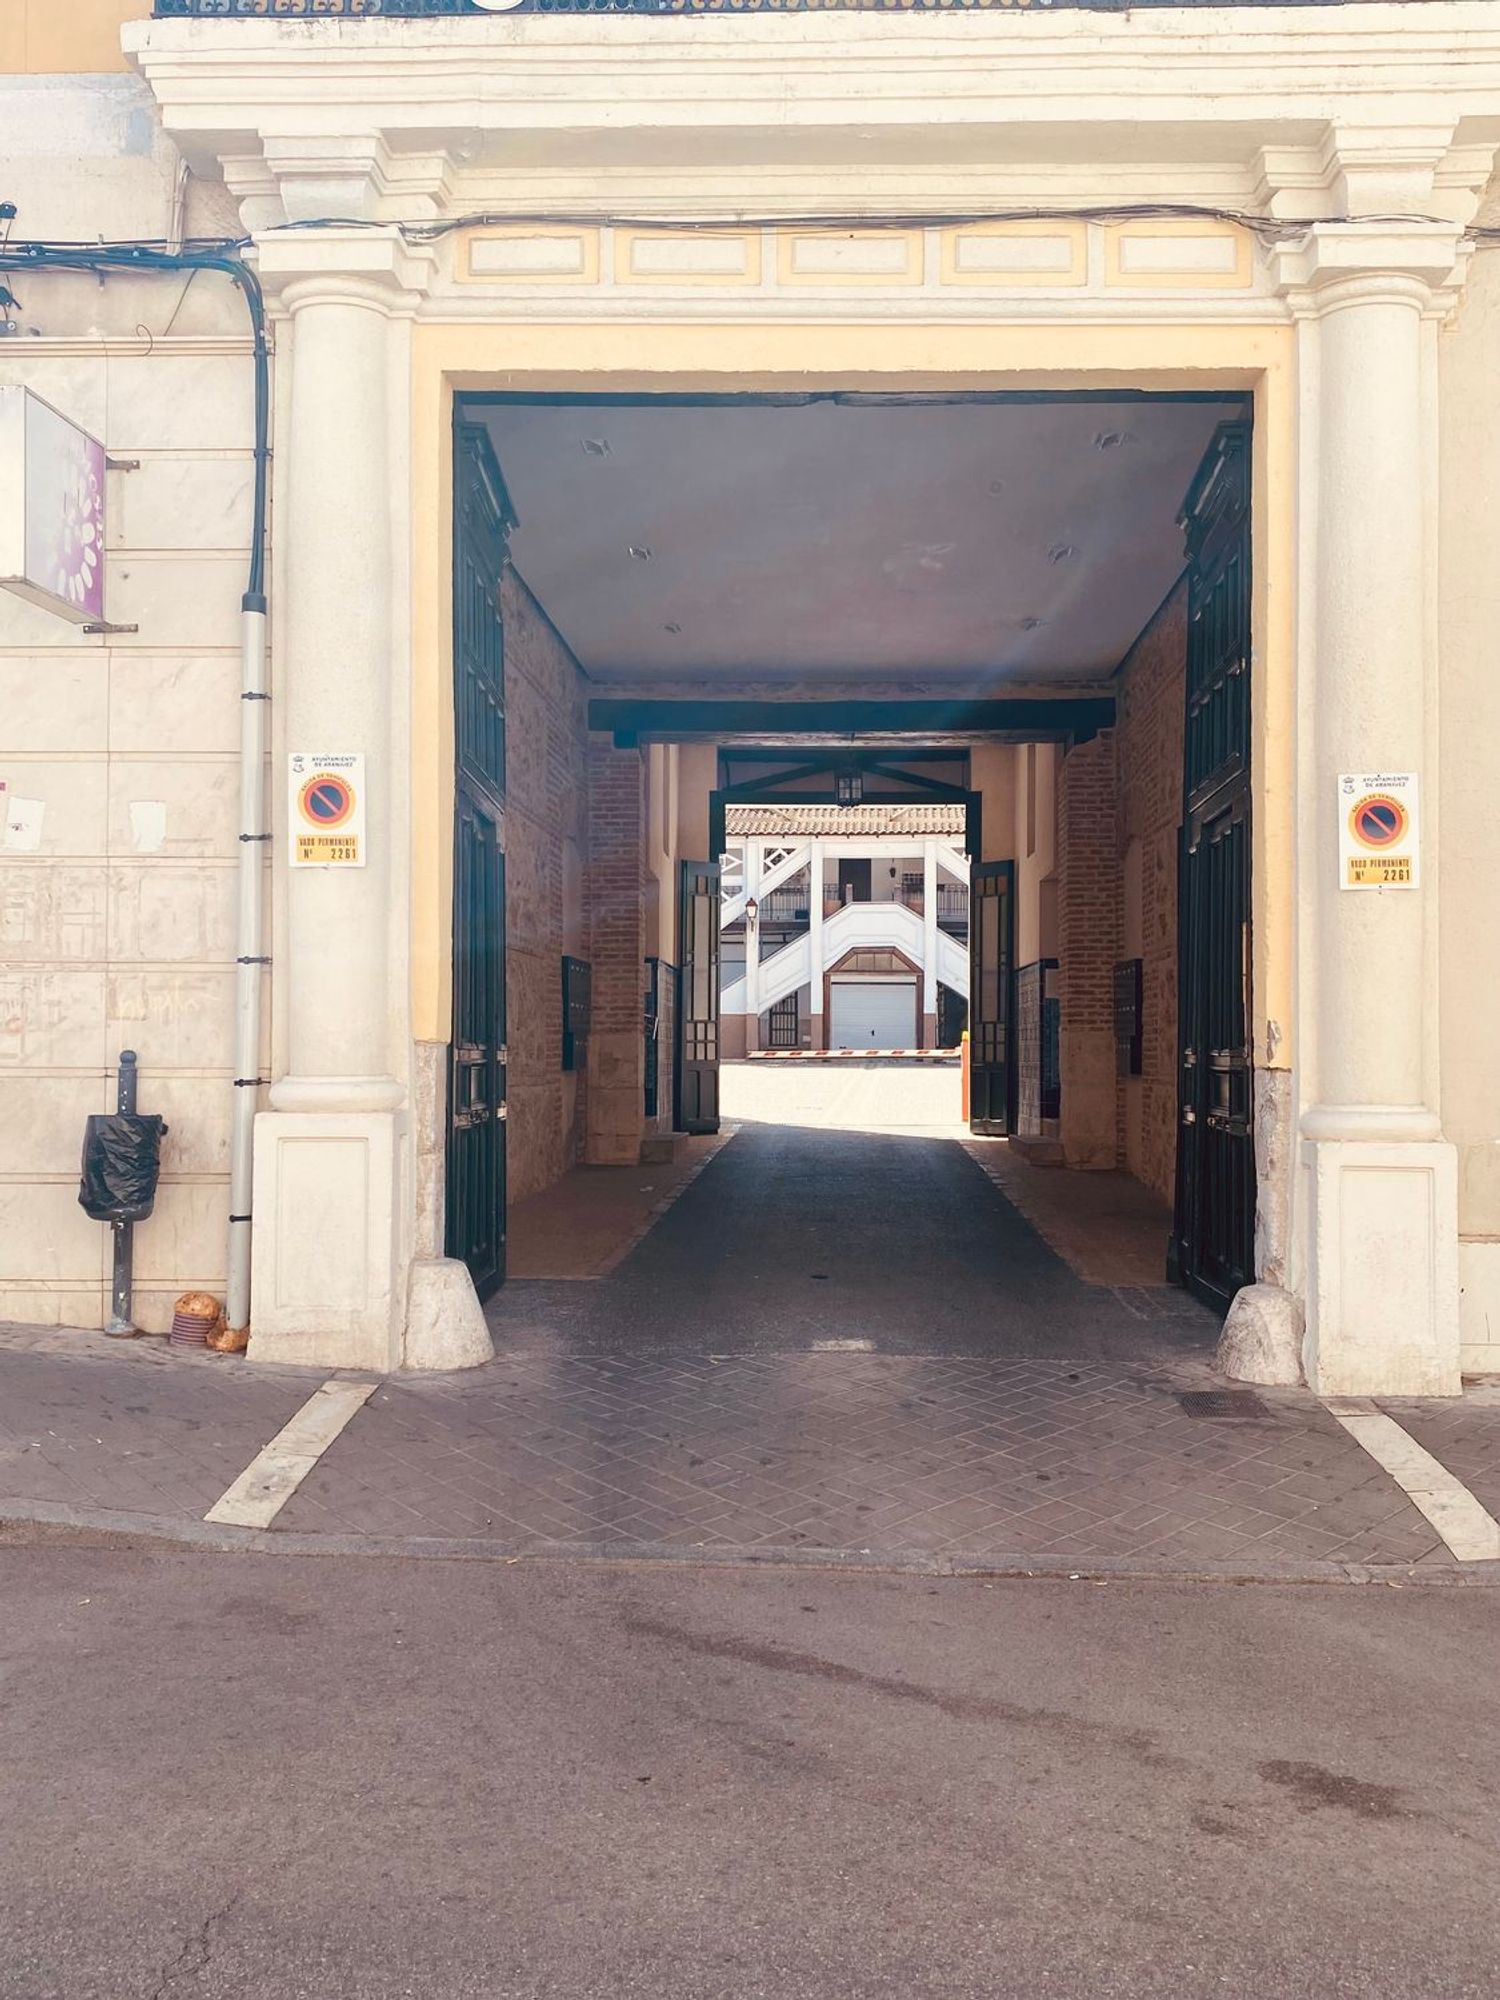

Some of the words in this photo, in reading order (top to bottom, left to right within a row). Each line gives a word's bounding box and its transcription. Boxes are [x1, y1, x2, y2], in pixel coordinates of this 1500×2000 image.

[299, 837, 315, 847] VADO
[318, 837, 356, 847] PERMANENTE
[331, 848, 356, 860] 2261
[1350, 859, 1367, 868] VADO
[1370, 858, 1410, 868] PERMANENTE
[1383, 869, 1410, 881] 2261
